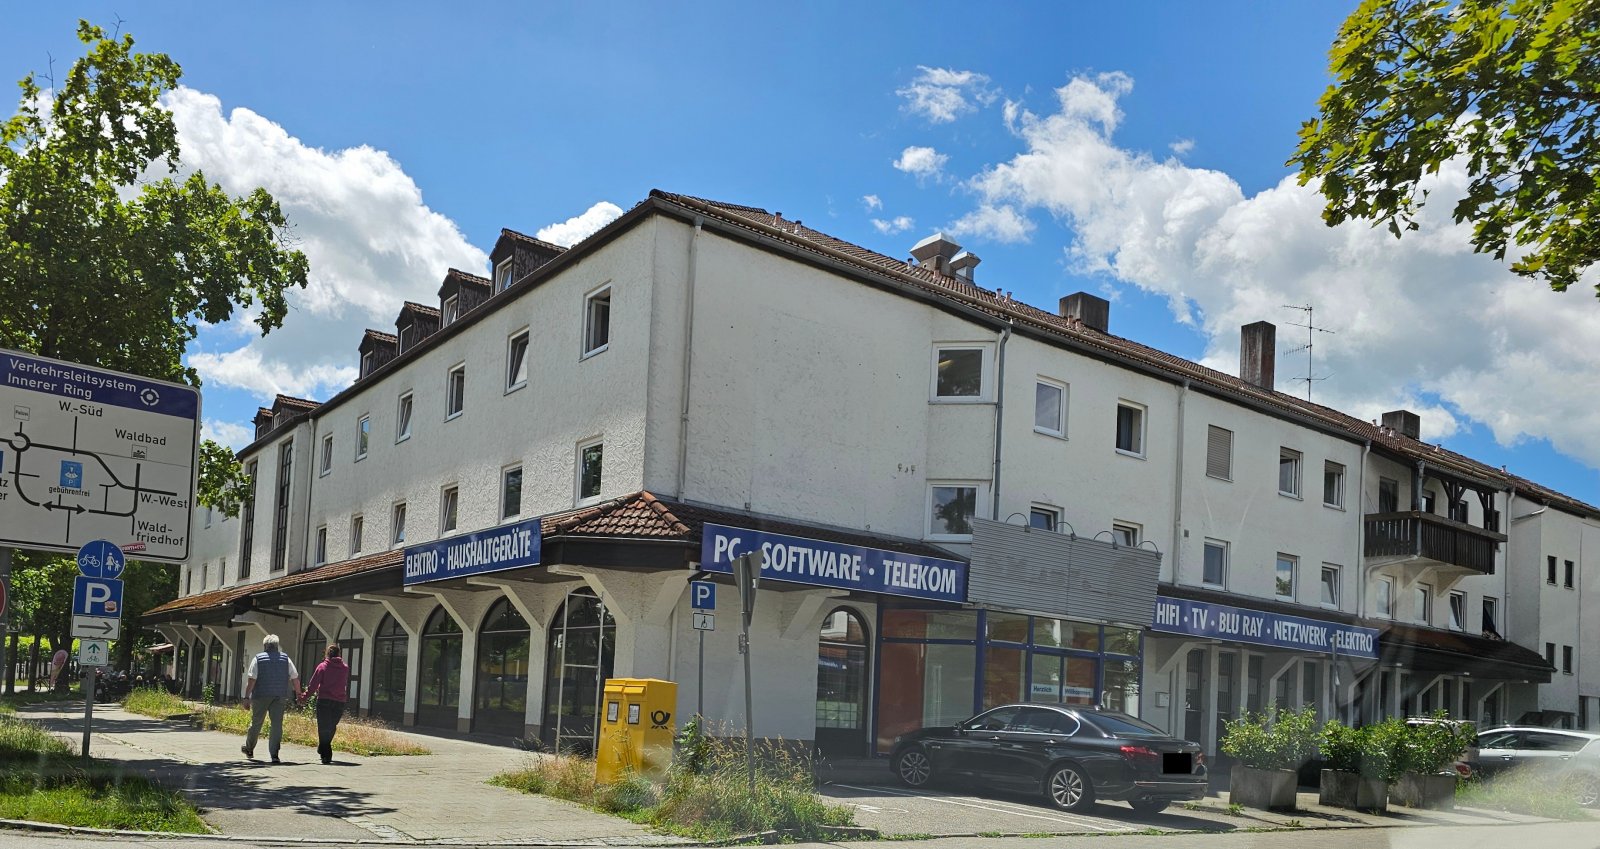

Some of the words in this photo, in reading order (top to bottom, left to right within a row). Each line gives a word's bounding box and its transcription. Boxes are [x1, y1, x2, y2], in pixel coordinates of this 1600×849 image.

[9, 358, 137, 393] Verkehrsleitsystem
[7, 372, 58, 391] Innerer
[63, 383, 92, 400] Ring
[59, 400, 103, 417] W.-Süd
[115, 428, 167, 446] Waldbad
[48, 485, 90, 497] gebührenfrei
[140, 493, 188, 509] W.-West
[138, 520, 173, 533] Wald-
[136, 532, 184, 547] friedhof
[406, 549, 438, 578] ELEKTRO
[447, 527, 531, 571] HAUSHALTGERÄTE
[713, 534, 741, 563] PC
[761, 541, 861, 582] SOFTWARE
[882, 559, 956, 594] TELEKOM
[84, 582, 112, 614] P
[697, 585, 710, 605] P
[1156, 602, 1180, 626] HIFI
[1191, 607, 1208, 630] TV
[1218, 611, 1240, 634] BLU
[1242, 615, 1264, 638] RAY
[1273, 620, 1328, 647] NETZWERK
[1336, 629, 1373, 653] ELEKTRO
